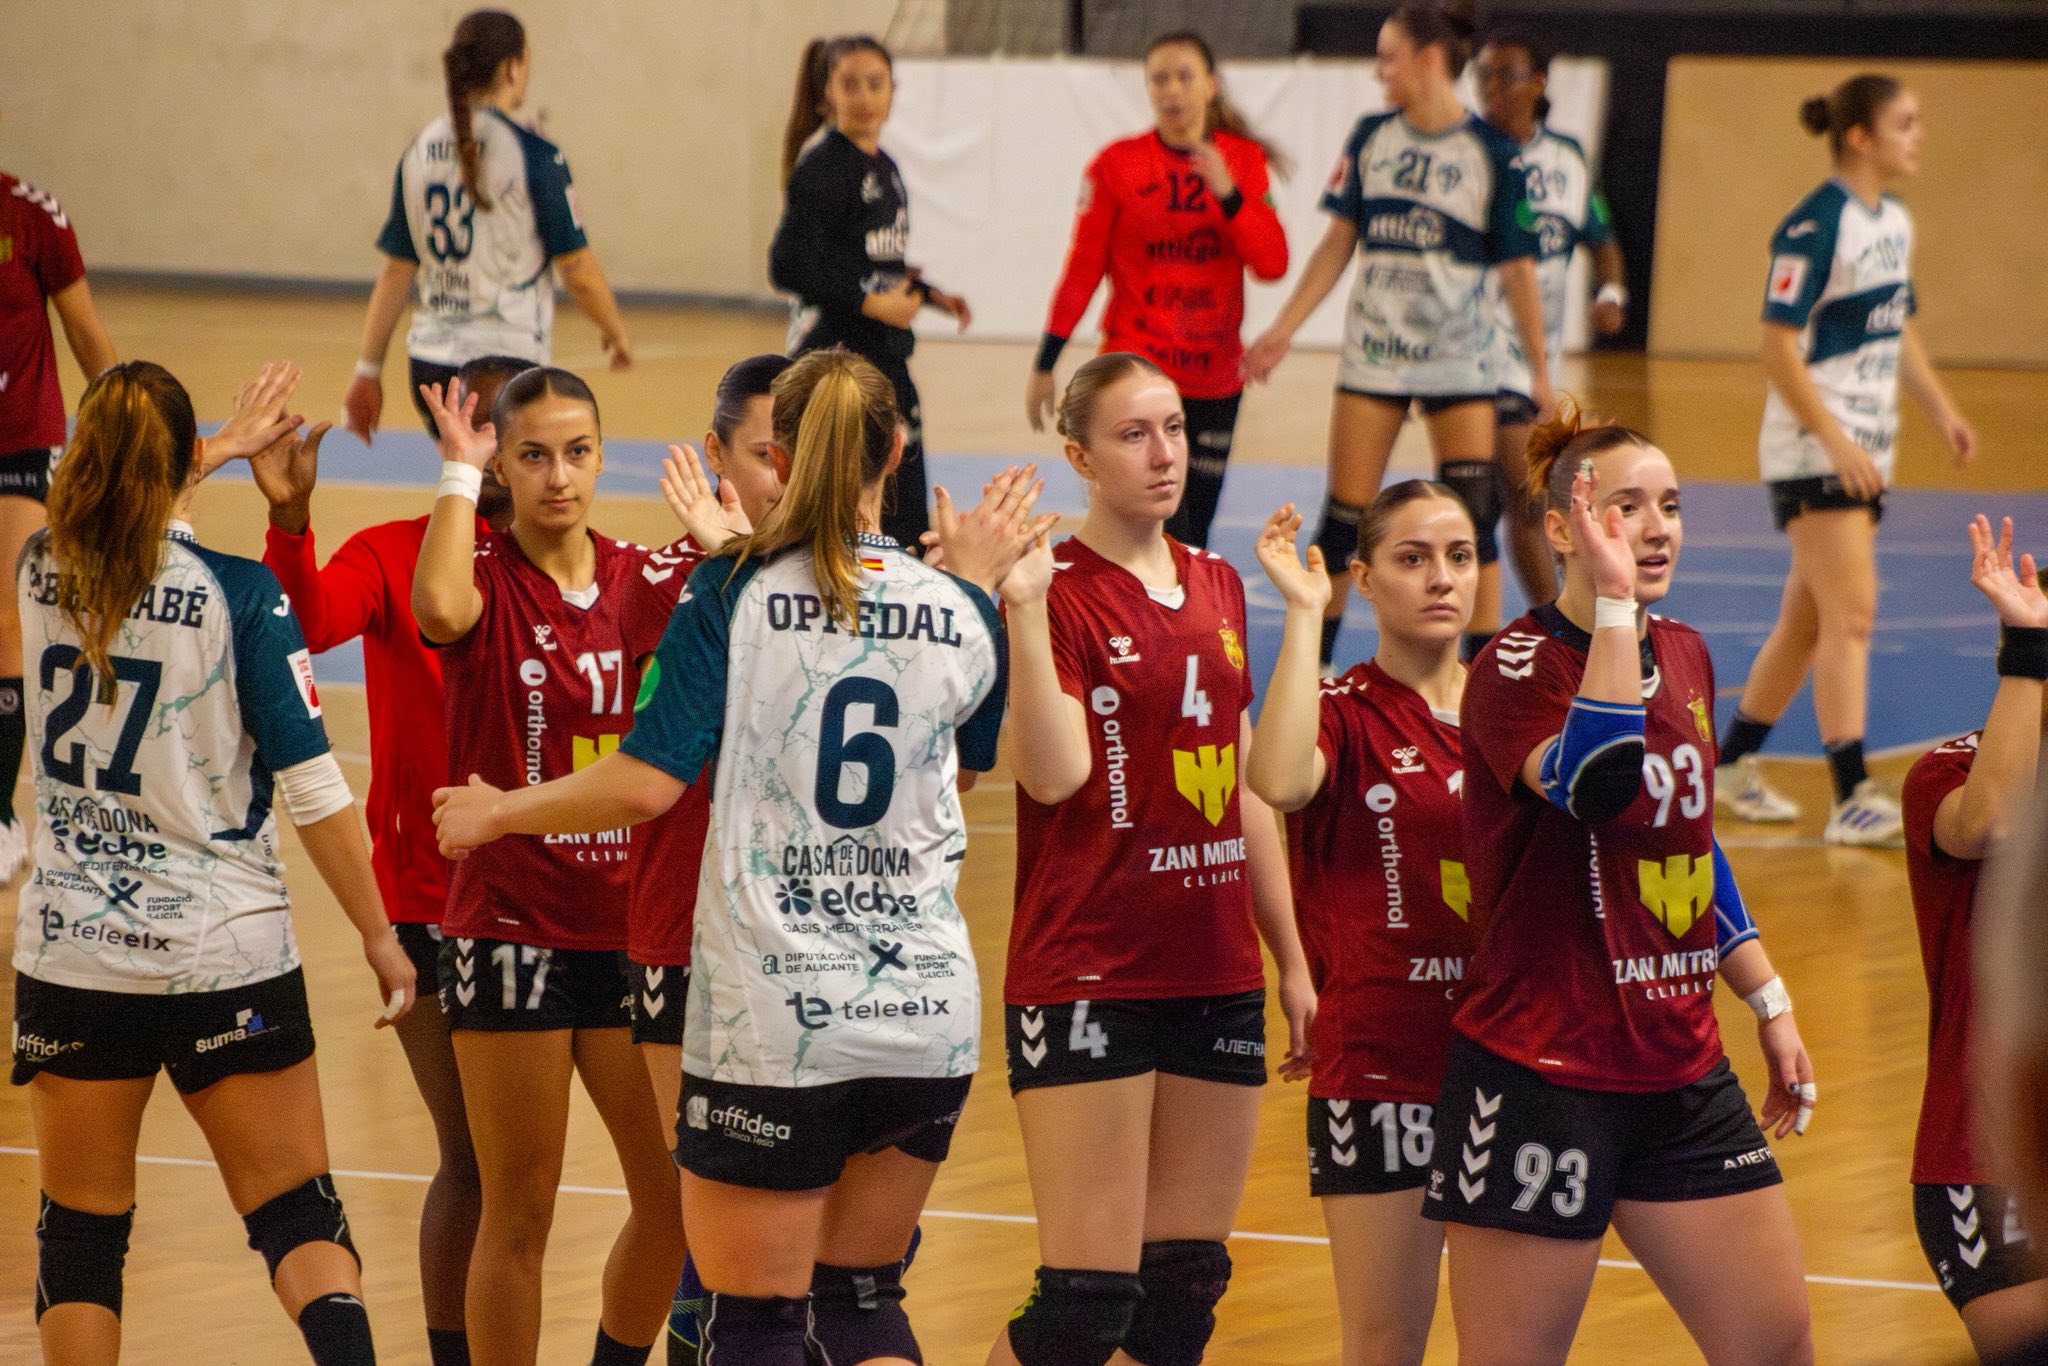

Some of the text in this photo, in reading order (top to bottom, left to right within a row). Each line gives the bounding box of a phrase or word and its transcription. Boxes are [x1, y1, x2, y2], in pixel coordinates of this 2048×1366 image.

[1166, 171, 1206, 212] 12
[1392, 150, 1431, 193] 21
[424, 184, 475, 260] 33
[576, 650, 622, 714] 17
[1181, 655, 1212, 727] 4
[40, 644, 163, 798] 27
[527, 690, 548, 784] orthomo
[814, 676, 899, 829] 6
[1103, 719, 1133, 829] orthomol
[1642, 743, 1706, 828] 93
[782, 844, 836, 876] CASA
[857, 845, 911, 877] DONA
[1148, 837, 1246, 872] ZAN MITRE
[1378, 816, 1409, 928] orthomol
[820, 880, 918, 918] elche
[72, 919, 172, 952] teleelx
[1612, 944, 1719, 984] ZAN MITR
[490, 944, 553, 1011] 17
[785, 962, 860, 974] DE ALICANTE
[1408, 956, 1464, 981] ZAN
[842, 995, 951, 1021] teleelx
[1068, 999, 1109, 1059] 4
[195, 1027, 248, 1053] suma
[710, 1105, 792, 1140] affidea
[1370, 1102, 1435, 1173] 18
[1510, 1142, 1588, 1218] 93
